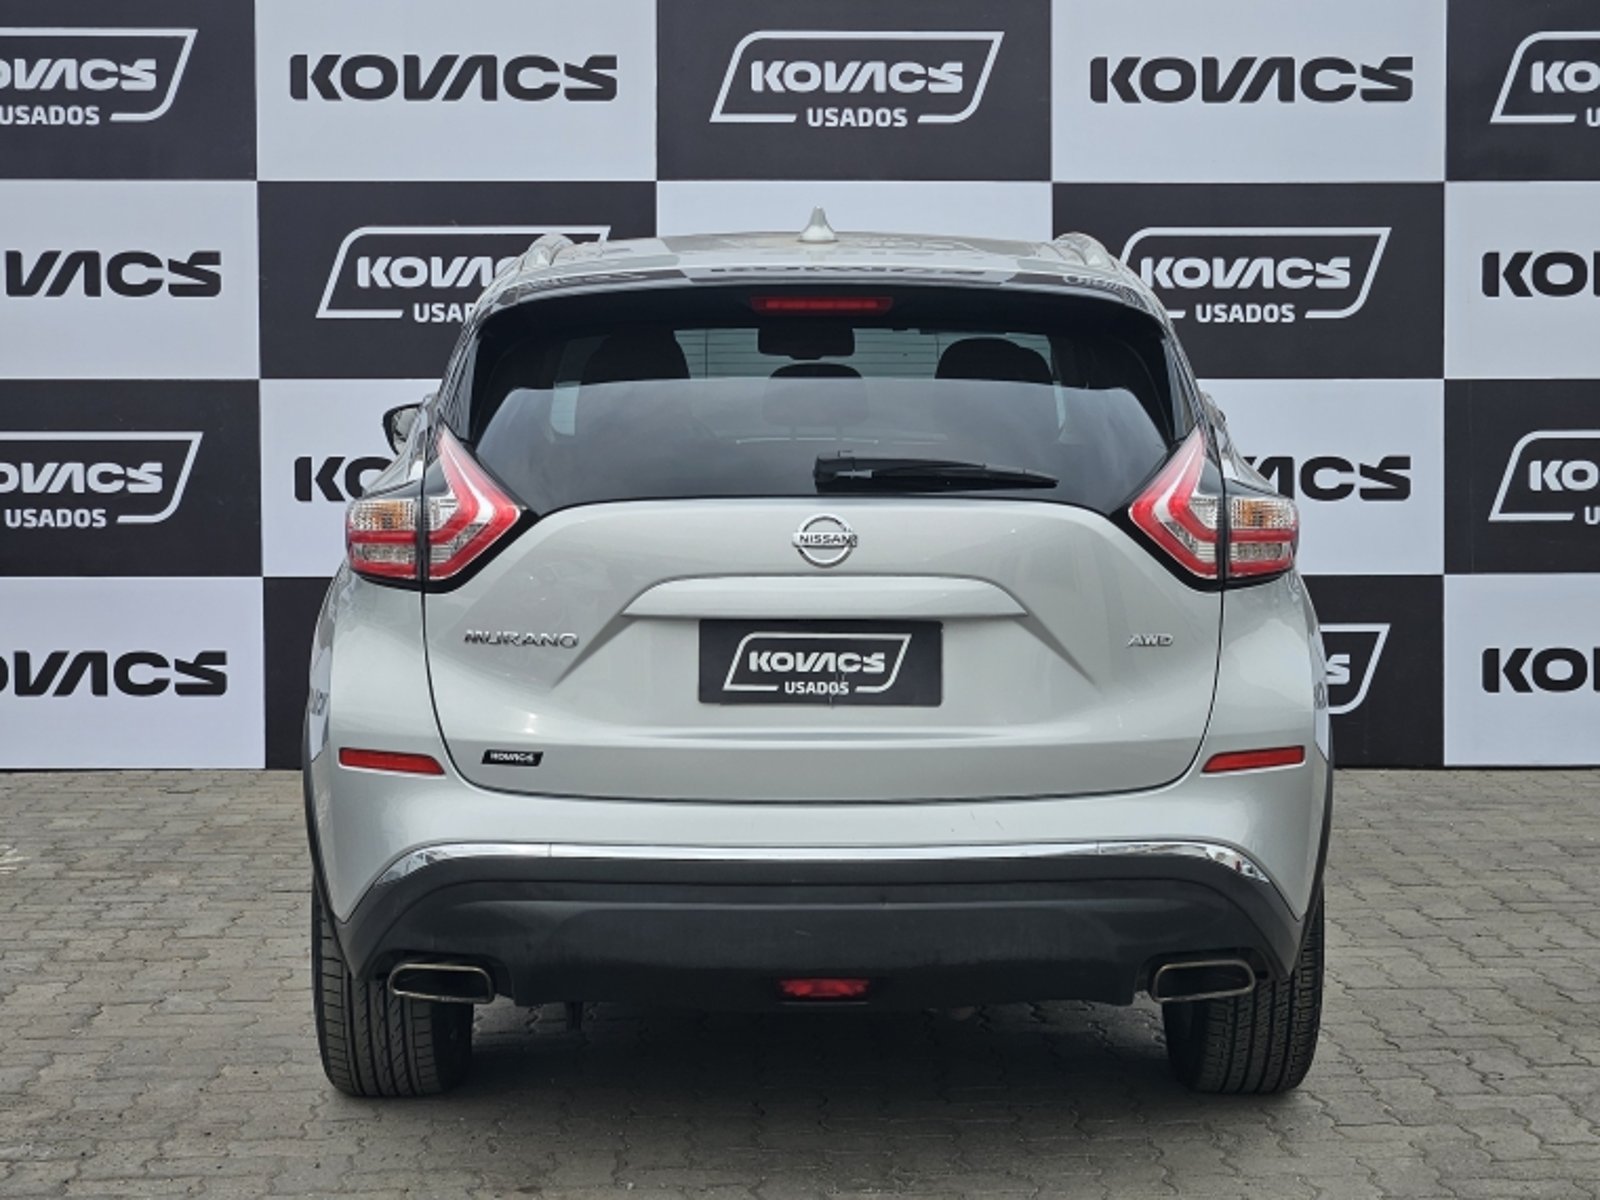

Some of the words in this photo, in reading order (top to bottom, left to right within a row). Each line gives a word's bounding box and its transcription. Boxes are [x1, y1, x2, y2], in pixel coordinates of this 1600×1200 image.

[0, 59, 157, 91] VACS
[290, 54, 618, 102] KOVACS
[750, 60, 963, 93] KOVACS
[1090, 56, 1414, 104] KOVACS
[0, 105, 100, 125] USADOS
[806, 107, 908, 127] USADOS
[1140, 257, 1350, 289] KOVACS
[1482, 251, 1600, 298] KO
[1195, 304, 1295, 323] USADOS
[1243, 455, 1411, 502] ACS
[5, 508, 107, 528] USADOS
[799, 533, 849, 545] NISSAN
[464, 628, 579, 649] MURANO
[1126, 632, 1173, 648] AWD
[0, 650, 228, 697] VACS
[749, 651, 885, 673] KOVACS
[1482, 647, 1600, 693] KO
[784, 681, 849, 695] USADOS
